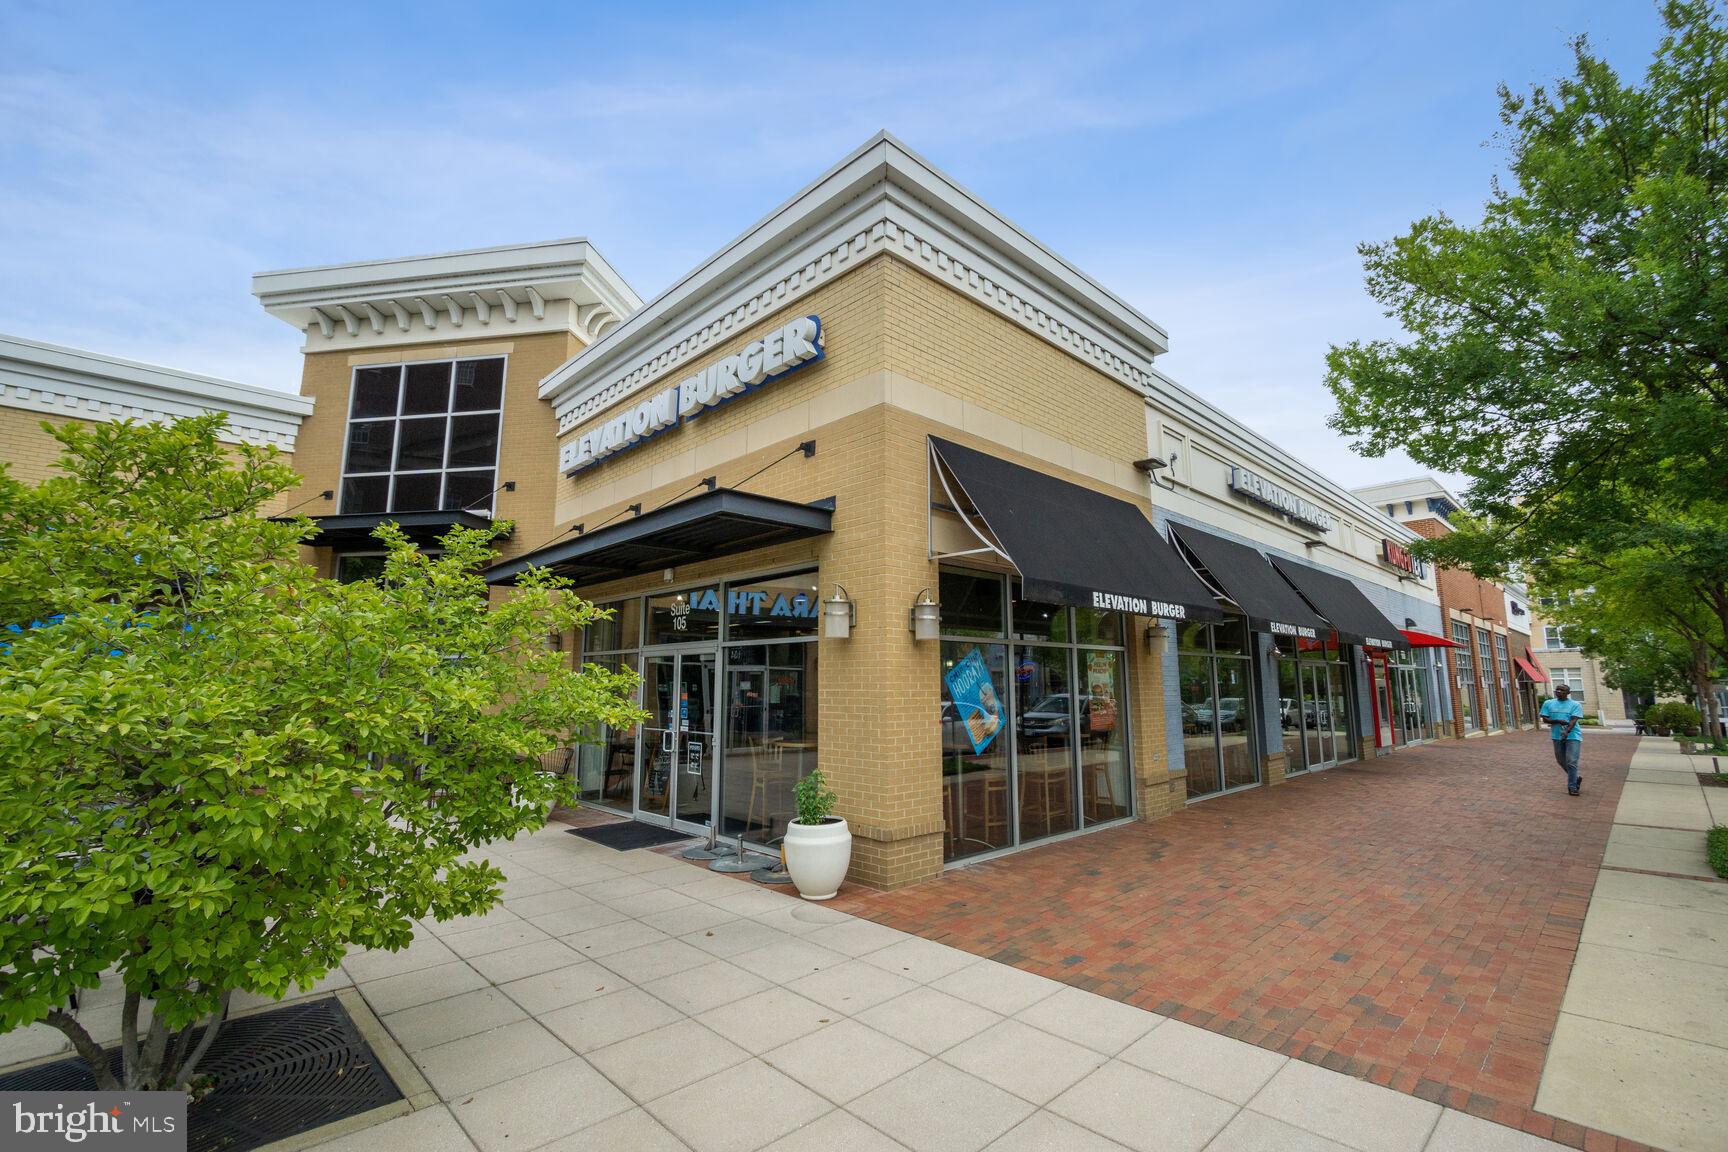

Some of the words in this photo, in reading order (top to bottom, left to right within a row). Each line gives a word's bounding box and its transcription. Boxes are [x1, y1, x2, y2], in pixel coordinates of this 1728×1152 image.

[560, 388, 678, 475] ELEVATION
[679, 316, 818, 417] BURGER
[1240, 470, 1297, 514] ELEVATION
[1299, 499, 1332, 530] BURGER
[670, 603, 690, 616] Suite
[1093, 591, 1147, 613] ELEVATION
[1151, 601, 1185, 618] BURGER
[673, 616, 687, 630] 105
[1270, 621, 1297, 635] ELEVATION
[1297, 626, 1317, 639] BURGER
